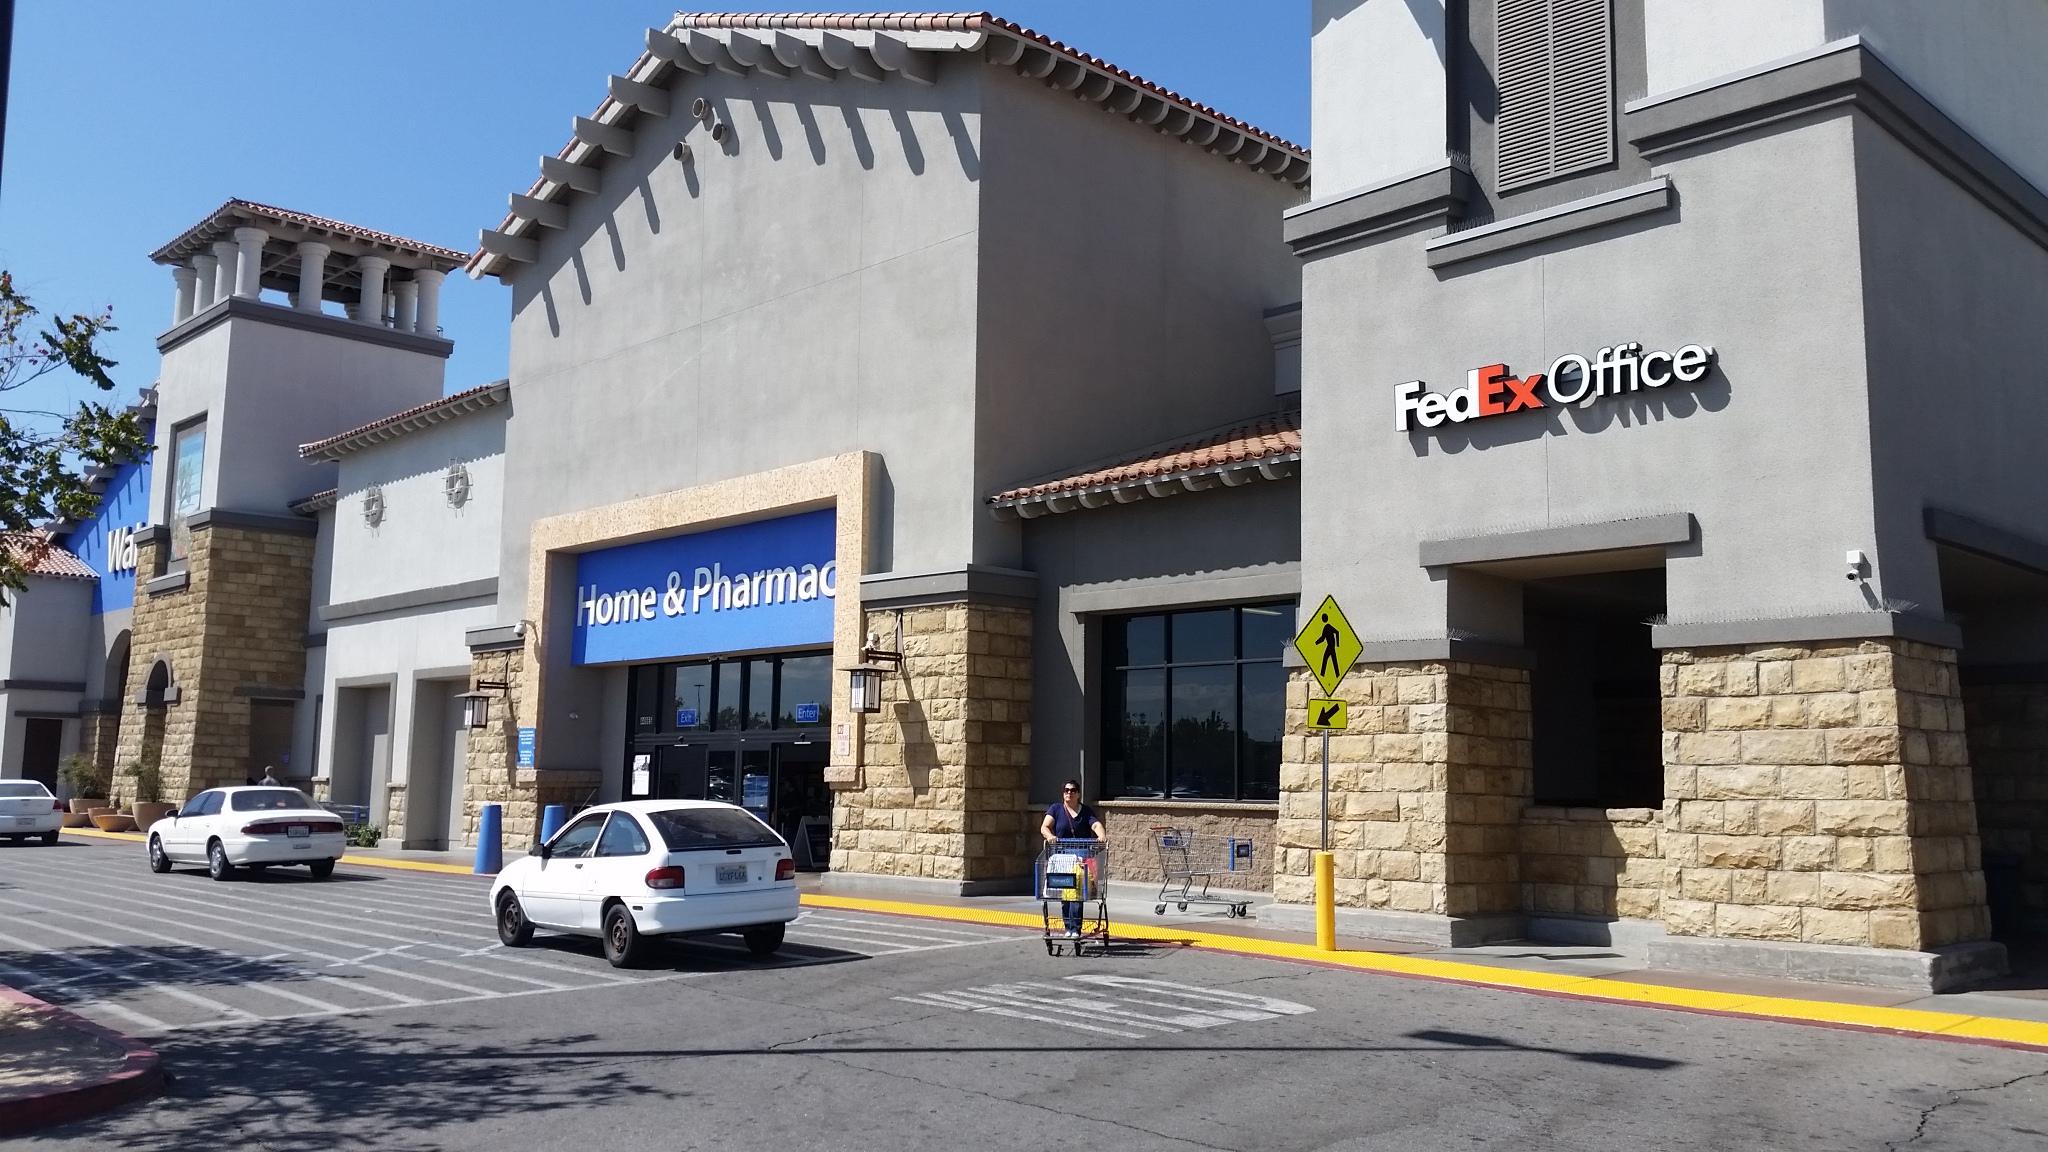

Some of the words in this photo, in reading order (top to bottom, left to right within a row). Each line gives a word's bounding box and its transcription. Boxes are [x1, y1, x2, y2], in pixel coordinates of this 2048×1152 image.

[1394, 363, 1546, 431] FedEx
[1547, 342, 1710, 403] Office
[577, 584, 656, 626] Home
[663, 571, 686, 617] &
[681, 713, 693, 723] Exit
[799, 707, 816, 719] Enter
